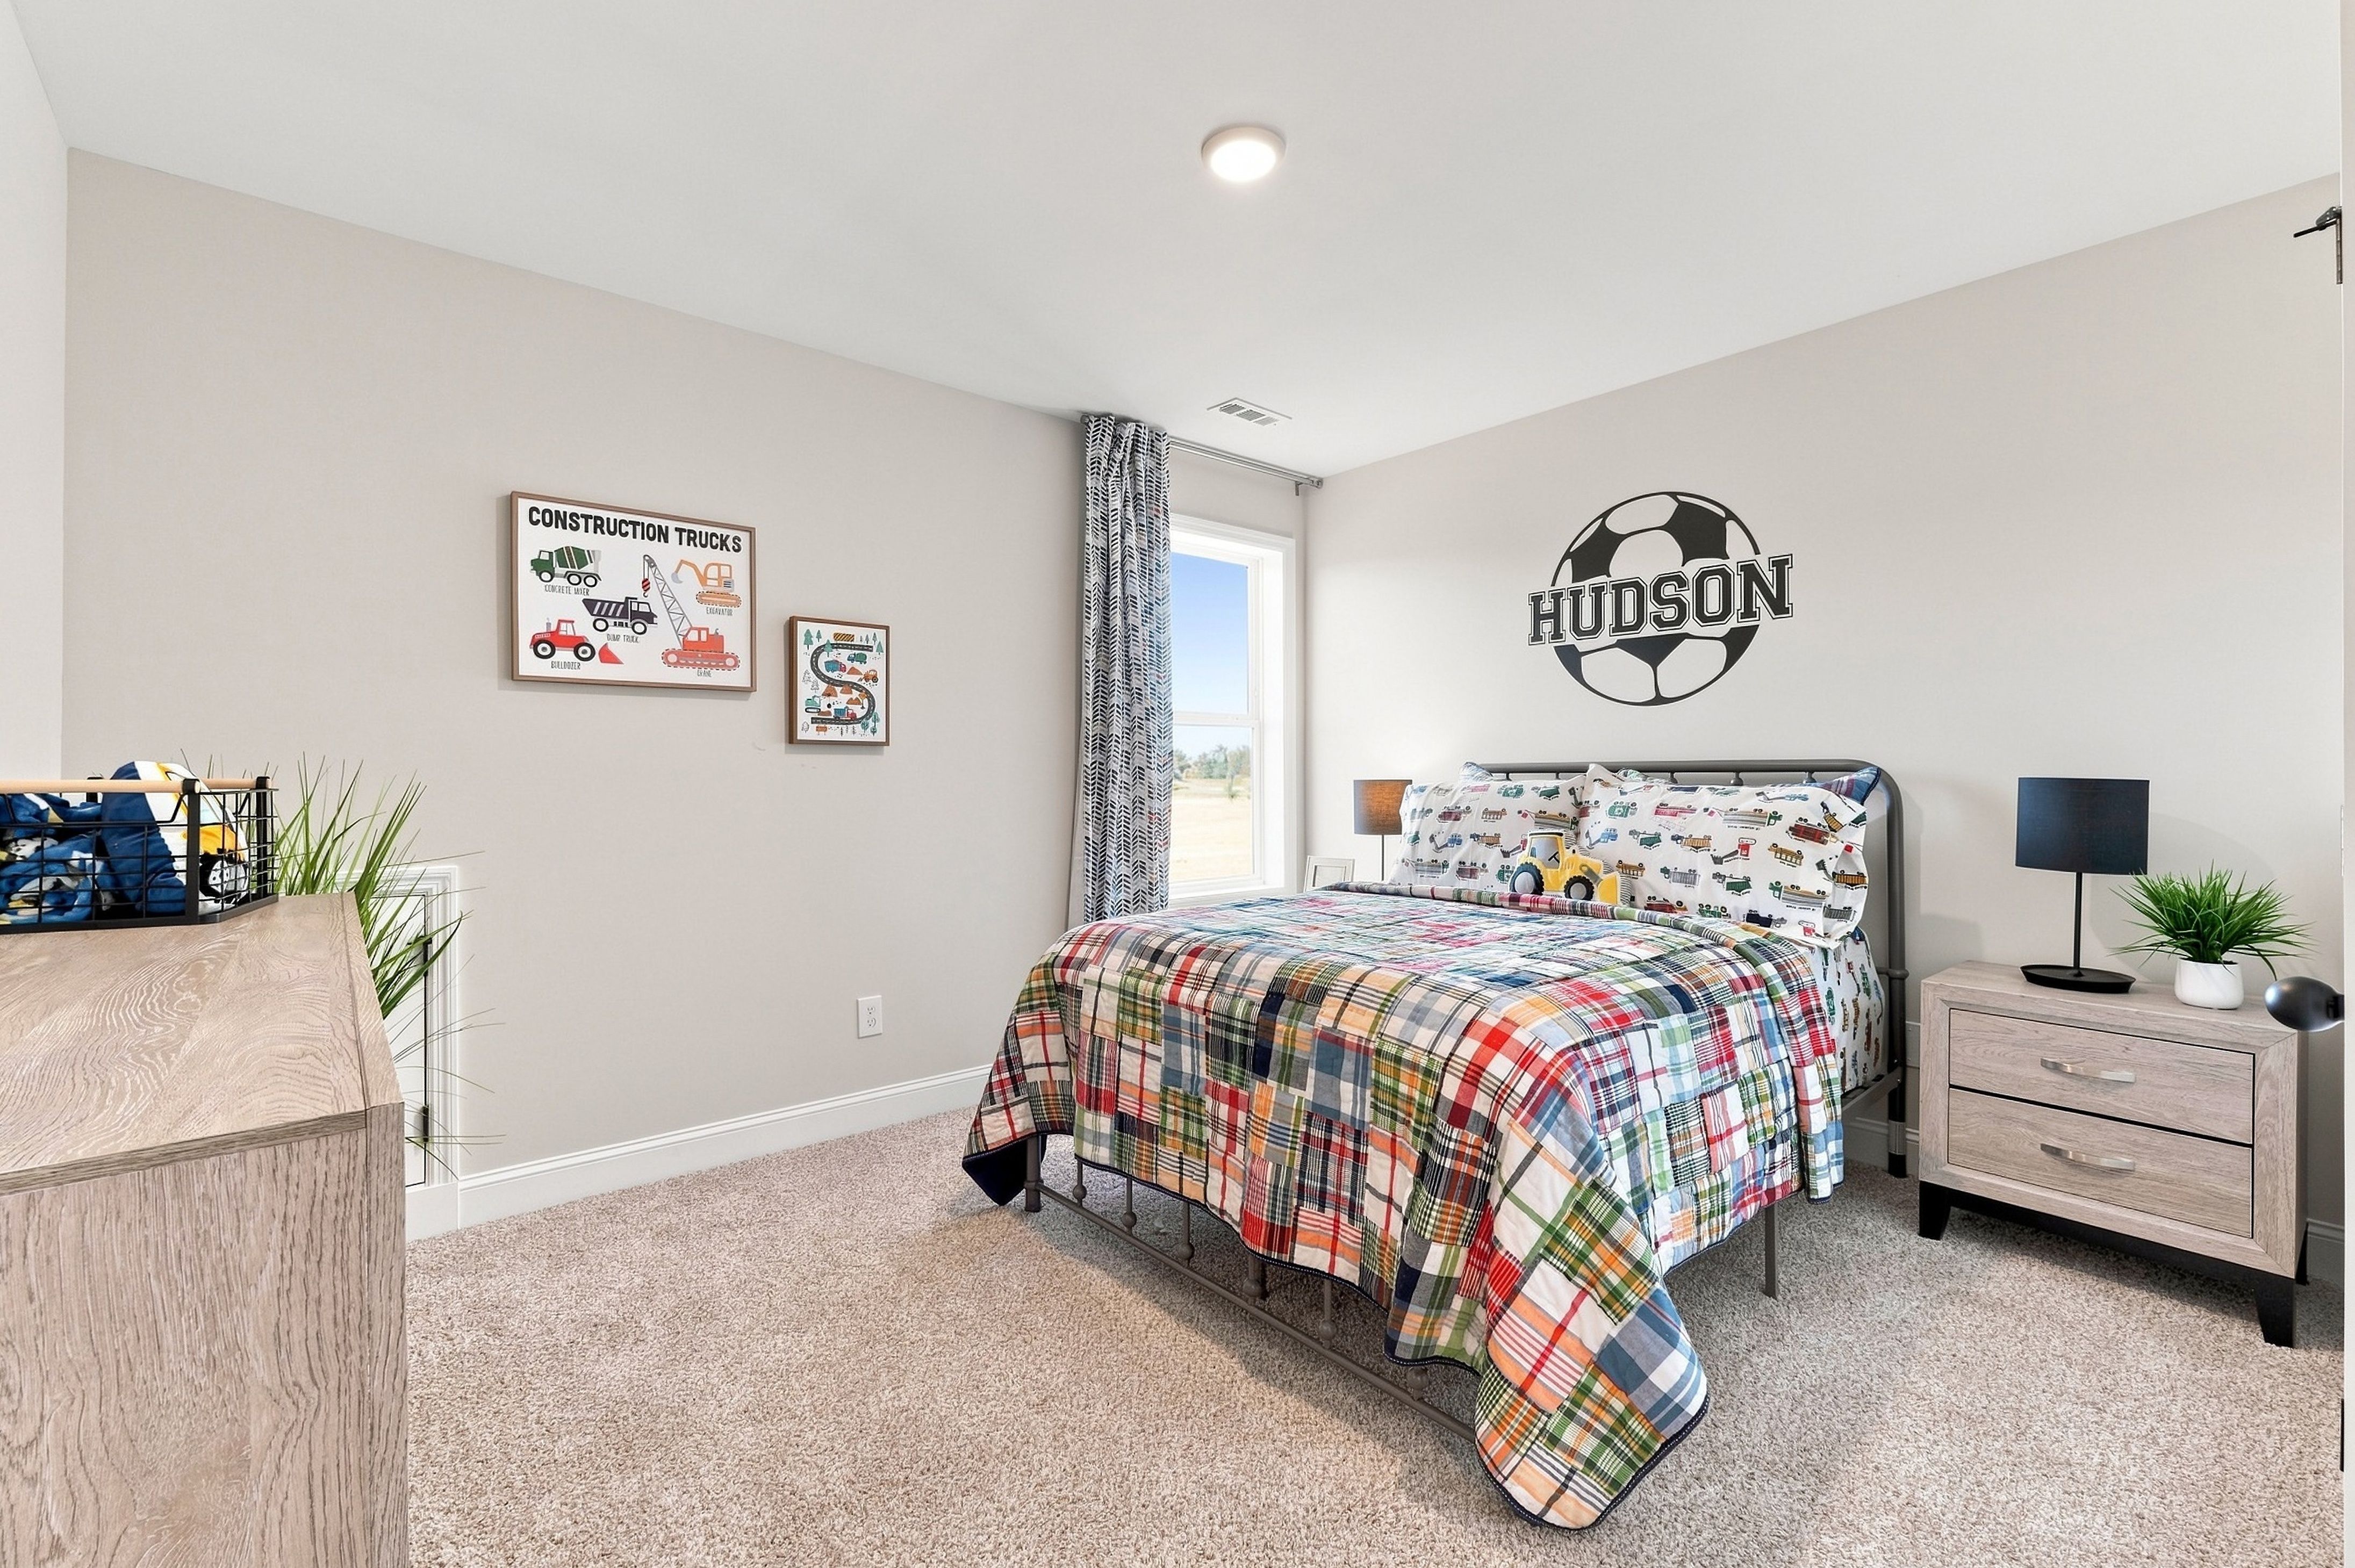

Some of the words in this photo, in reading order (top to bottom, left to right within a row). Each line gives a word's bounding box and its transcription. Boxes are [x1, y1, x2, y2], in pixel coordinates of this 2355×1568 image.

[528, 506, 669, 543] CONSTRUCTION
[674, 527, 742, 553] TRUCKS
[544, 584, 572, 594] CONCRETE
[1528, 553, 1793, 645] HUDSON
[551, 660, 581, 670] BULLDOZER
